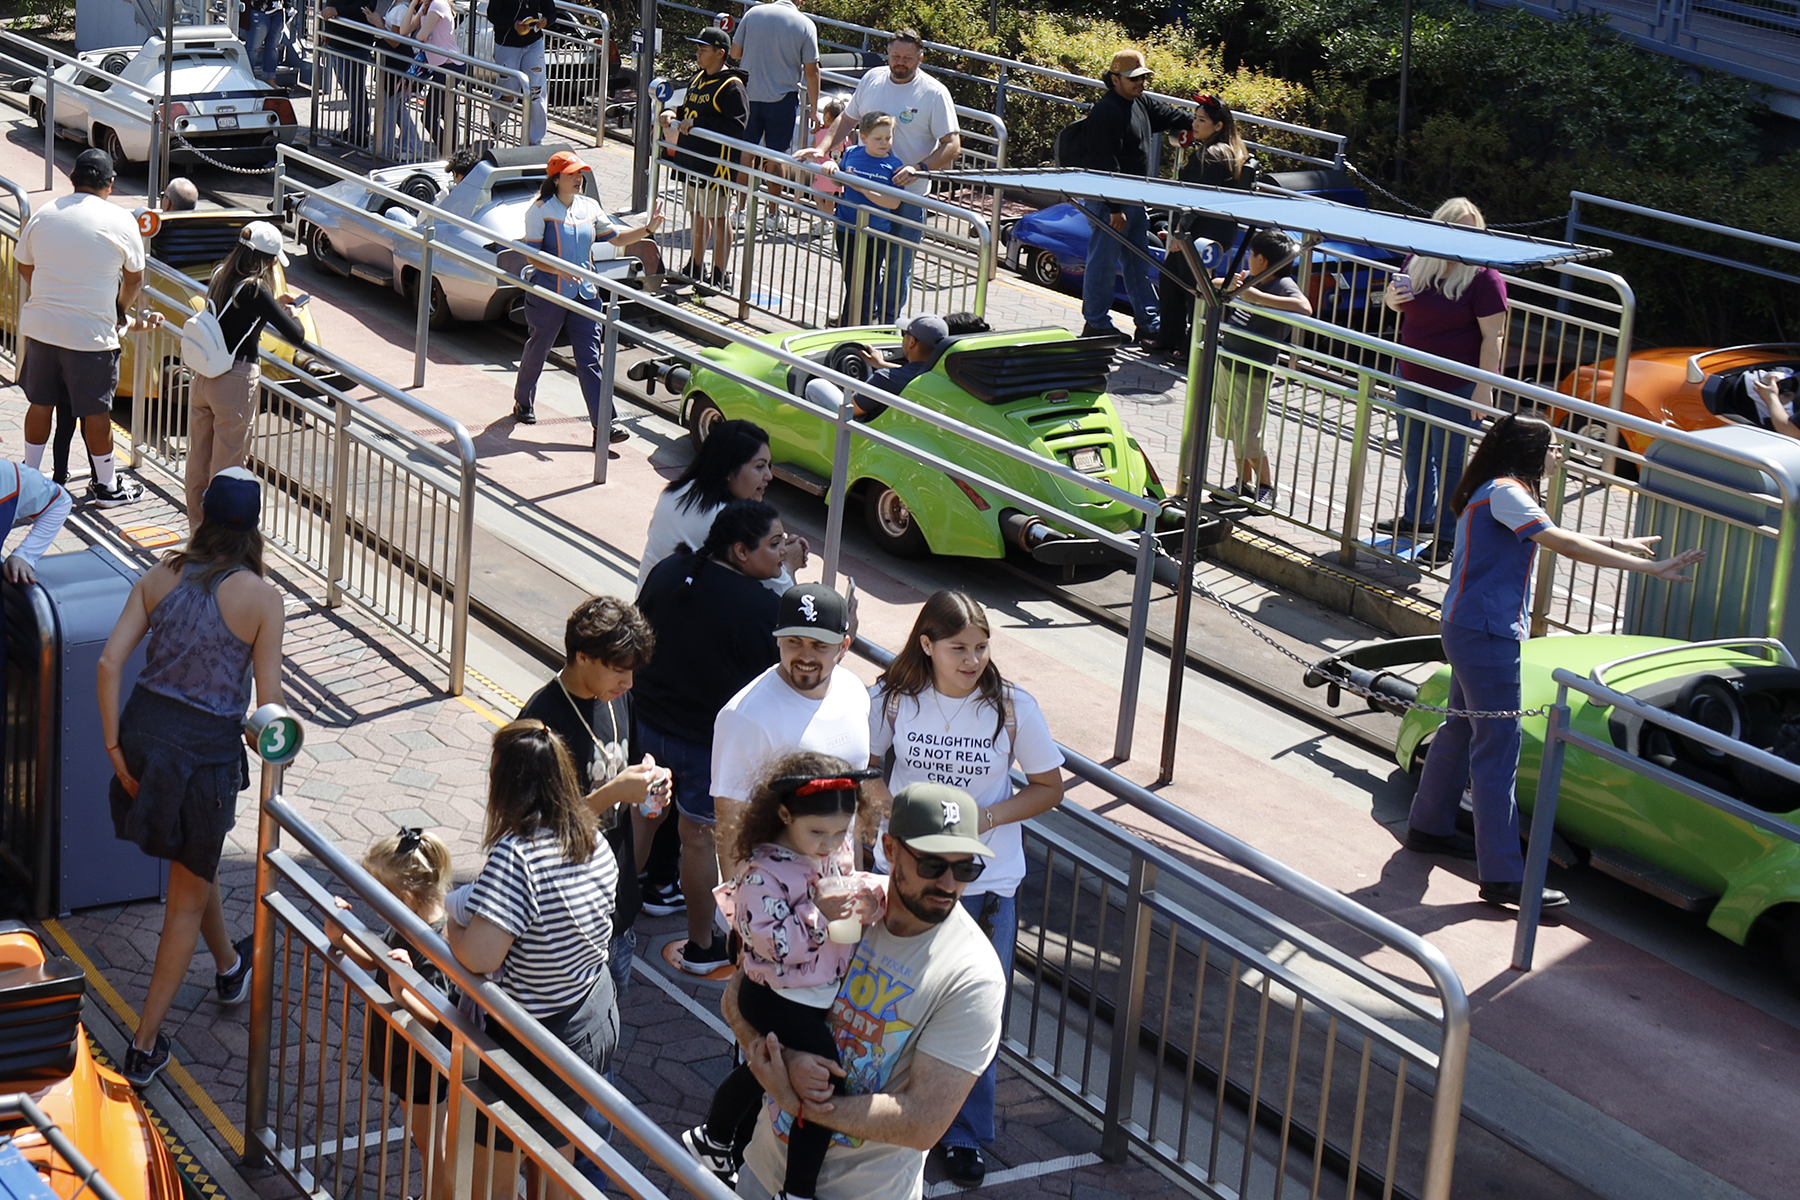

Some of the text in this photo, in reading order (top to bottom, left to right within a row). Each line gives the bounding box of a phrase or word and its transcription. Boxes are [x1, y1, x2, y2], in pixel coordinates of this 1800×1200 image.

[722, 18, 729, 30] 2
[658, 84, 666, 98] 2
[1180, 130, 1187, 144] 3
[846, 166, 888, 181] Champion
[141, 214, 151, 232] 3
[1203, 246, 1213, 263] 3
[267, 720, 285, 752] 3
[907, 732, 991, 749] GASLIGHTING
[909, 746, 991, 763] IS NOT REAL
[905, 758, 991, 776] YOU'RE JUST
[927, 773, 972, 787] CRAZY
[881, 956, 913, 976] PIXAR
[838, 954, 915, 1020] TOY
[832, 999, 879, 1037] TORY
